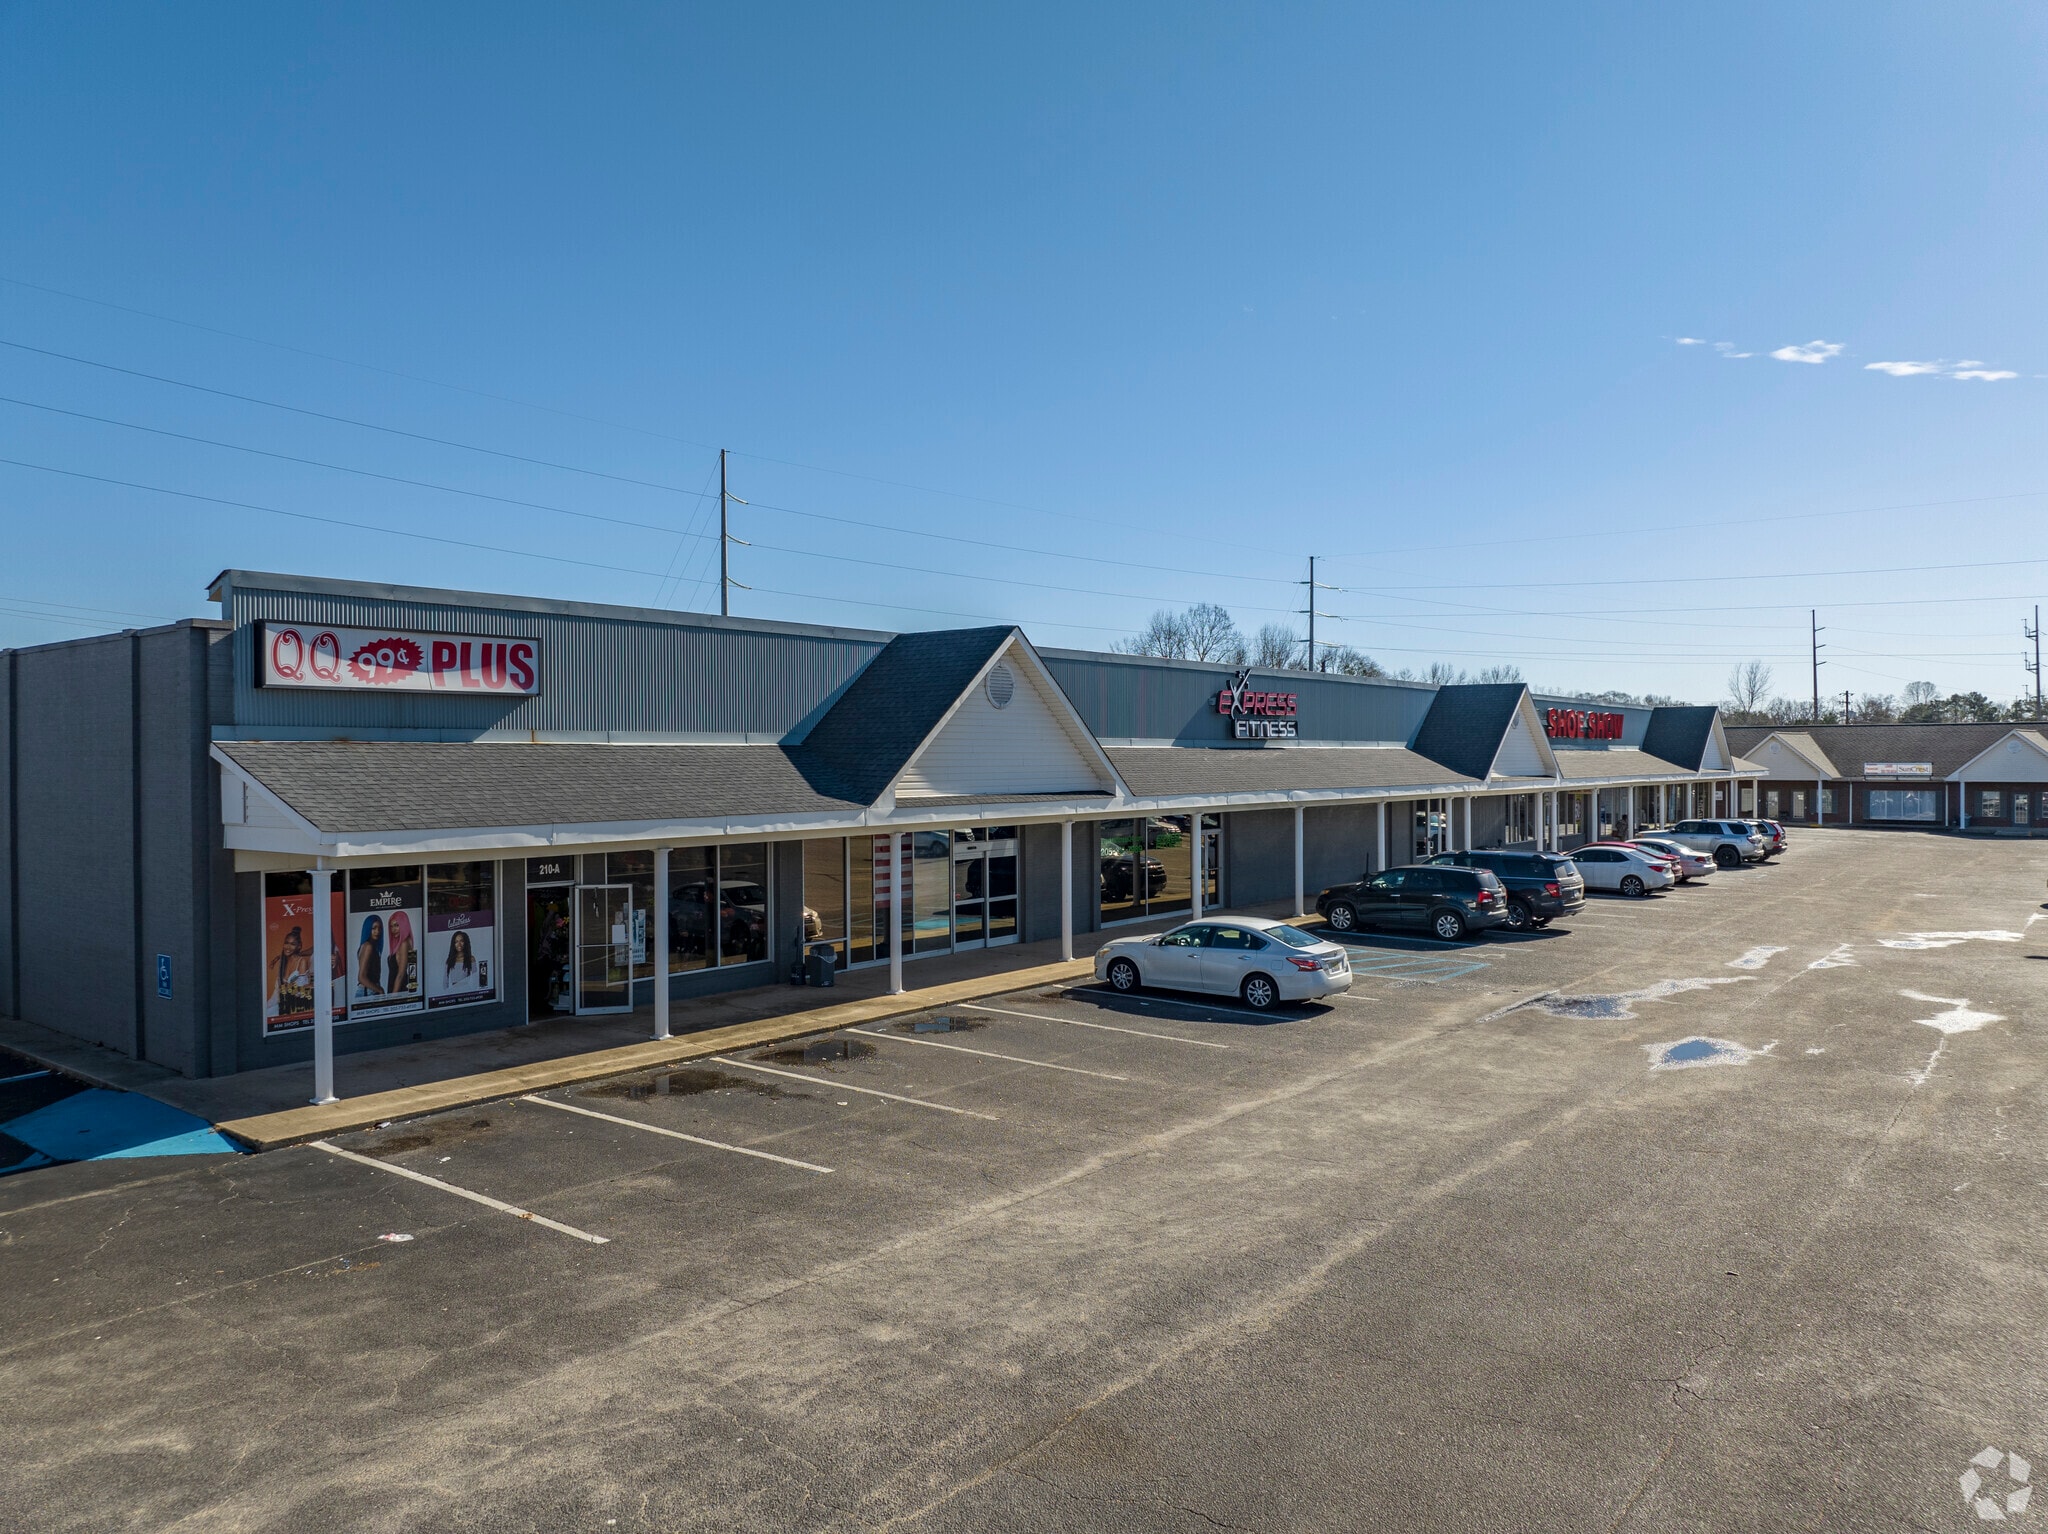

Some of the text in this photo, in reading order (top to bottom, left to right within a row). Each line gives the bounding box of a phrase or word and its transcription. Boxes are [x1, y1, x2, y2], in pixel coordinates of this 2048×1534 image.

[432, 640, 535, 690] PLUS
[1237, 720, 1296, 737] FITNESS
[1548, 708, 1624, 741] SHOE SHOW
[539, 863, 561, 875] 210-A
